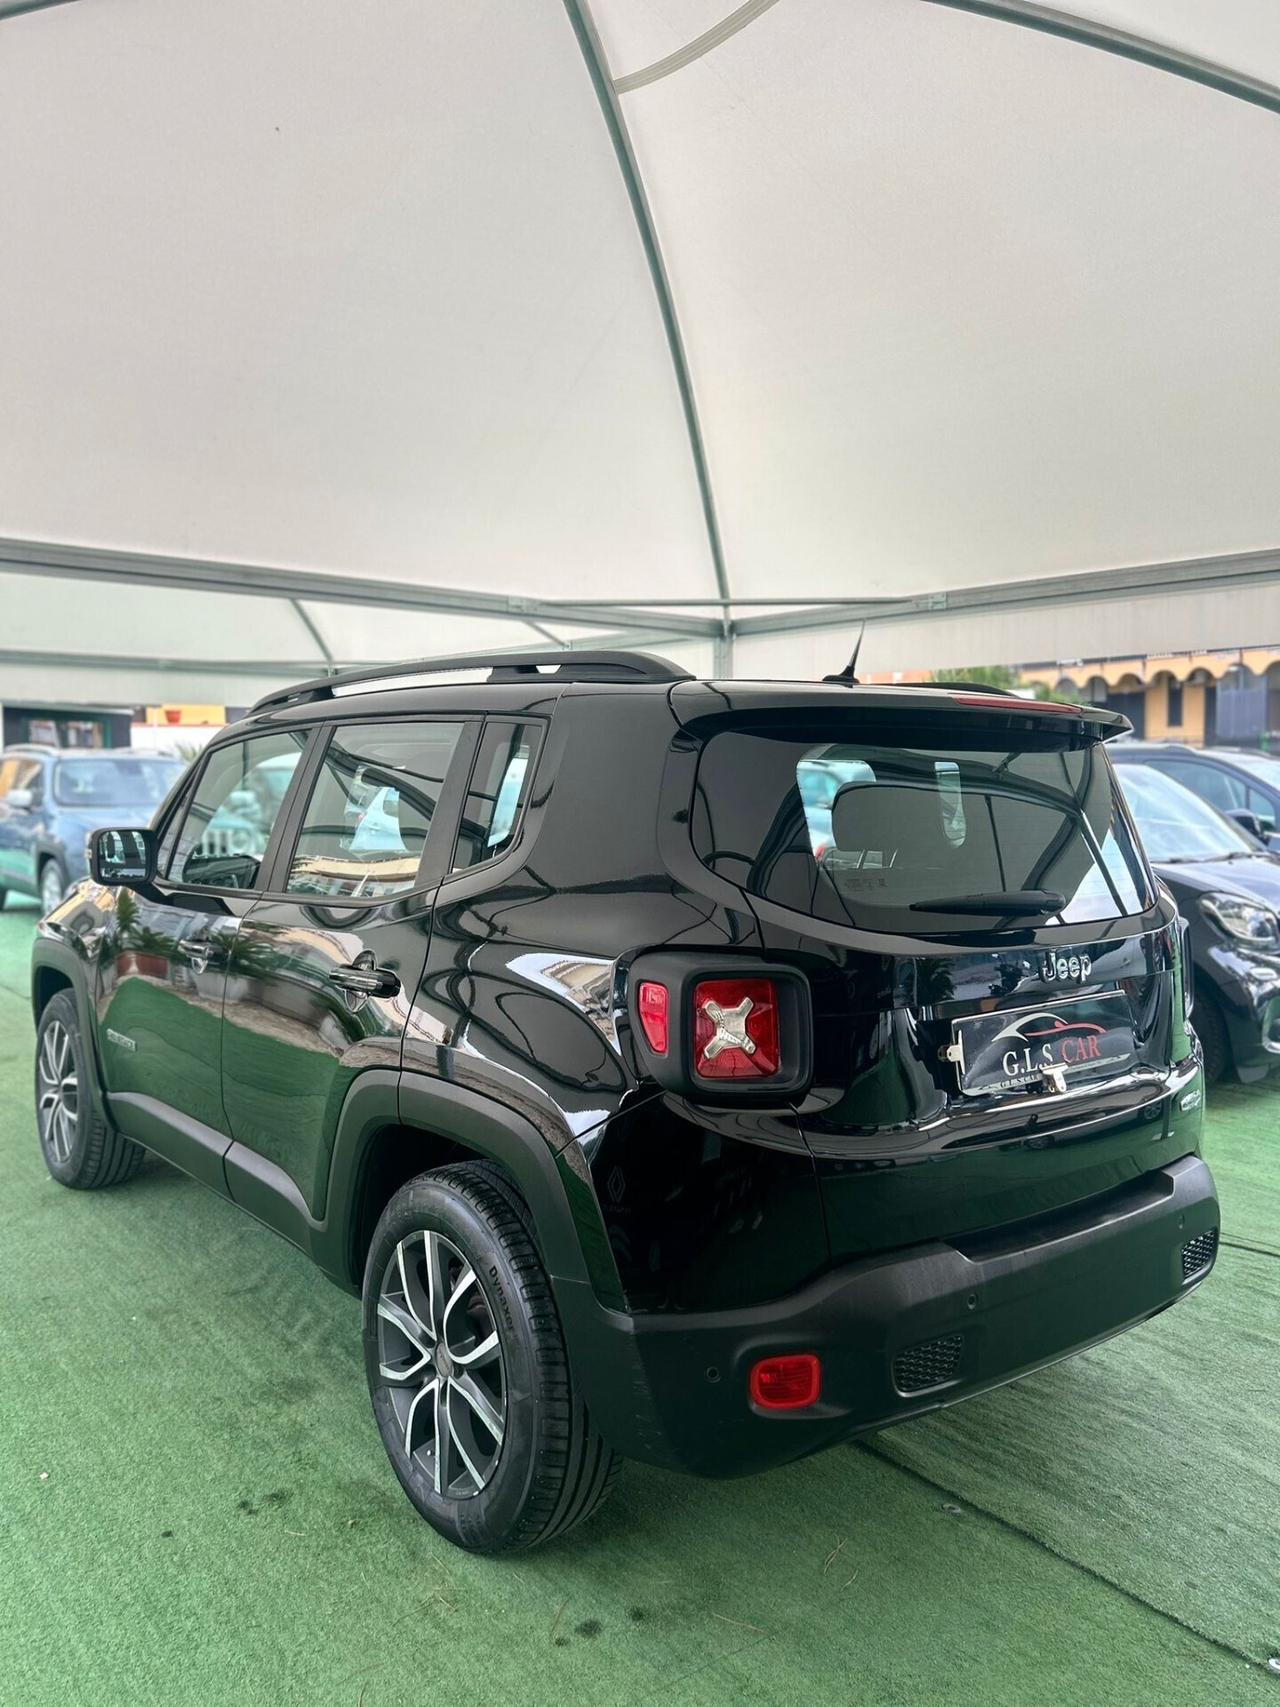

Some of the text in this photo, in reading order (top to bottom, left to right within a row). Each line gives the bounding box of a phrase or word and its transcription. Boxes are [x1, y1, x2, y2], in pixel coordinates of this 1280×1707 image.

[1042, 951, 1092, 982] Jeep
[1062, 1035, 1101, 1063] CAR
[489, 1265, 514, 1330] Dynaxer
